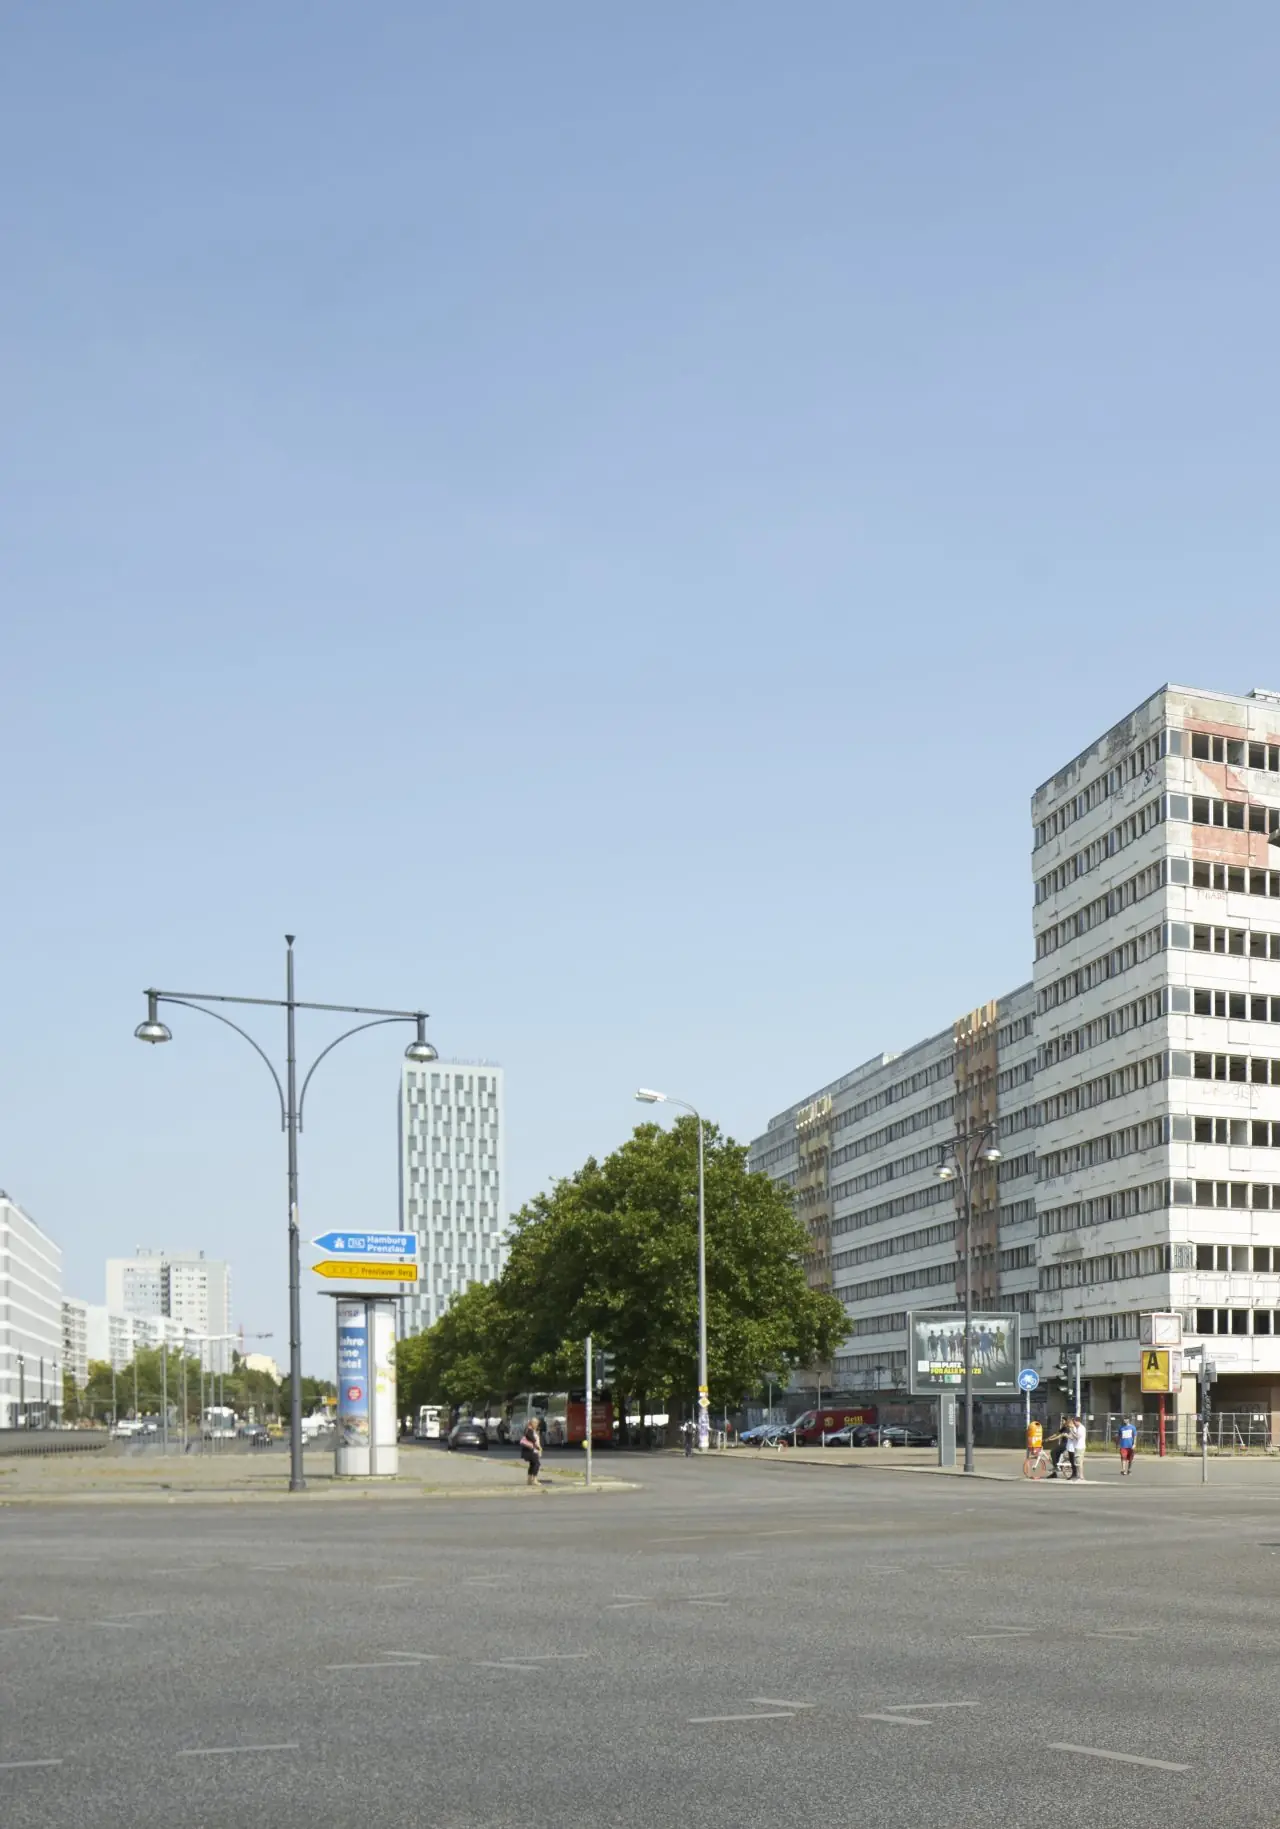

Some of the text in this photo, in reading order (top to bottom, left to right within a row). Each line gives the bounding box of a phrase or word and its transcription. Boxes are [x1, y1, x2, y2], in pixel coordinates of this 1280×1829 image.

[367, 1236, 407, 1246] Hamburg
[367, 1244, 405, 1252] Prenzlau
[1147, 1352, 1160, 1370] A
